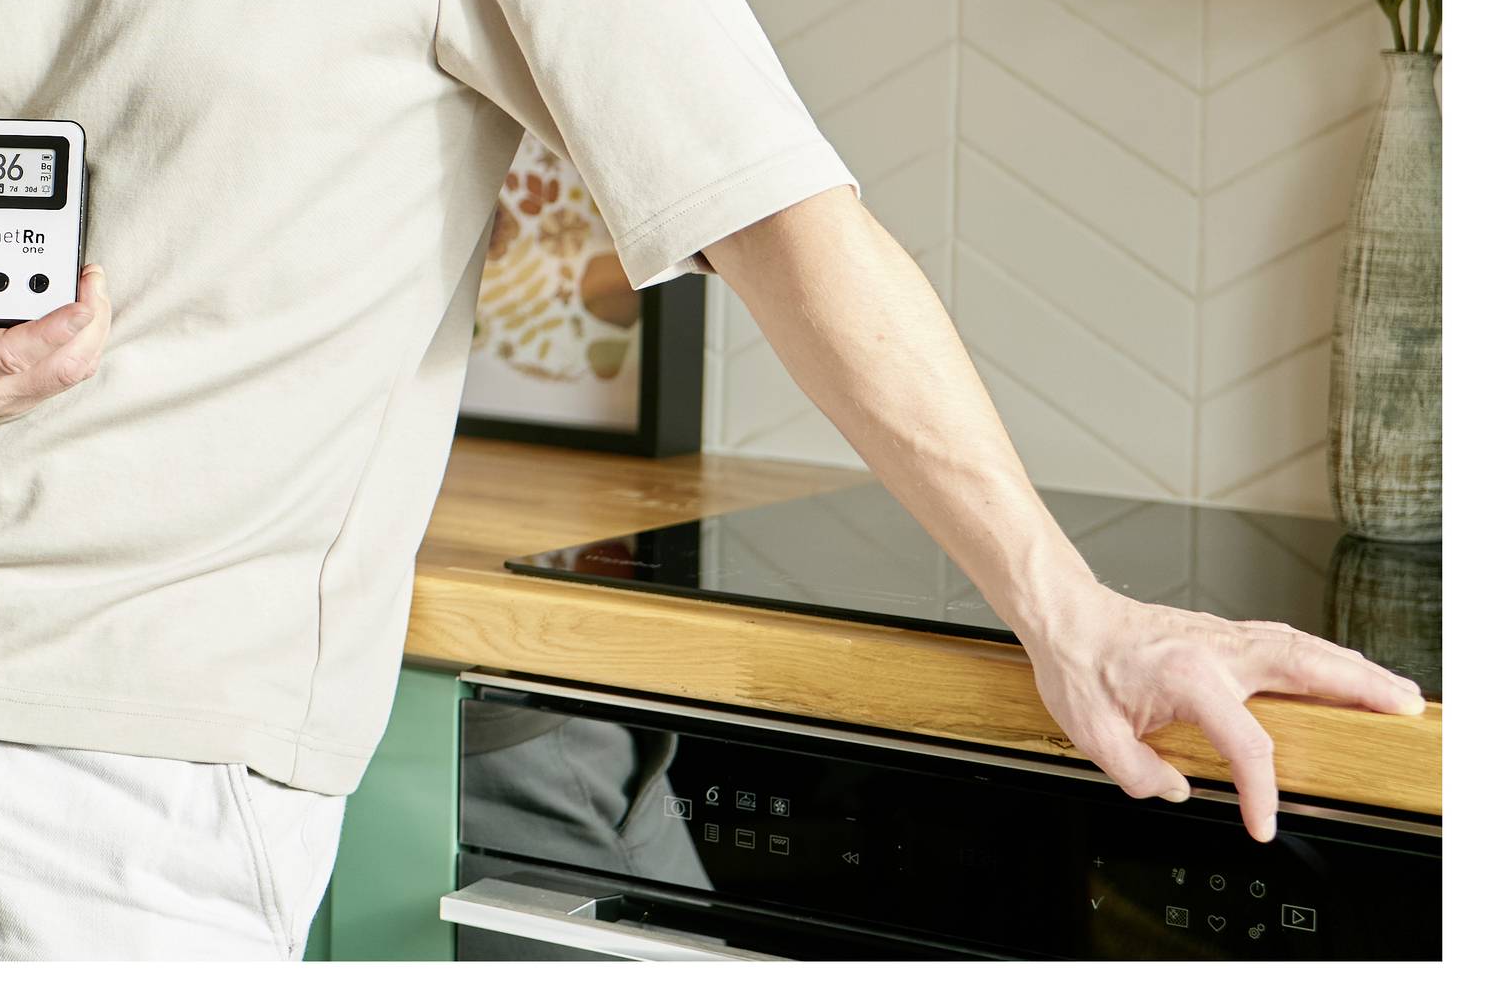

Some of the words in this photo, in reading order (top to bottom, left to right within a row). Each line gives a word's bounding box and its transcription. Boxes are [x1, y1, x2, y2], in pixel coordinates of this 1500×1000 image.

[41, 163, 52, 172] Bq
[22, 246, 45, 254] one
[706, 785, 720, 802] 6
